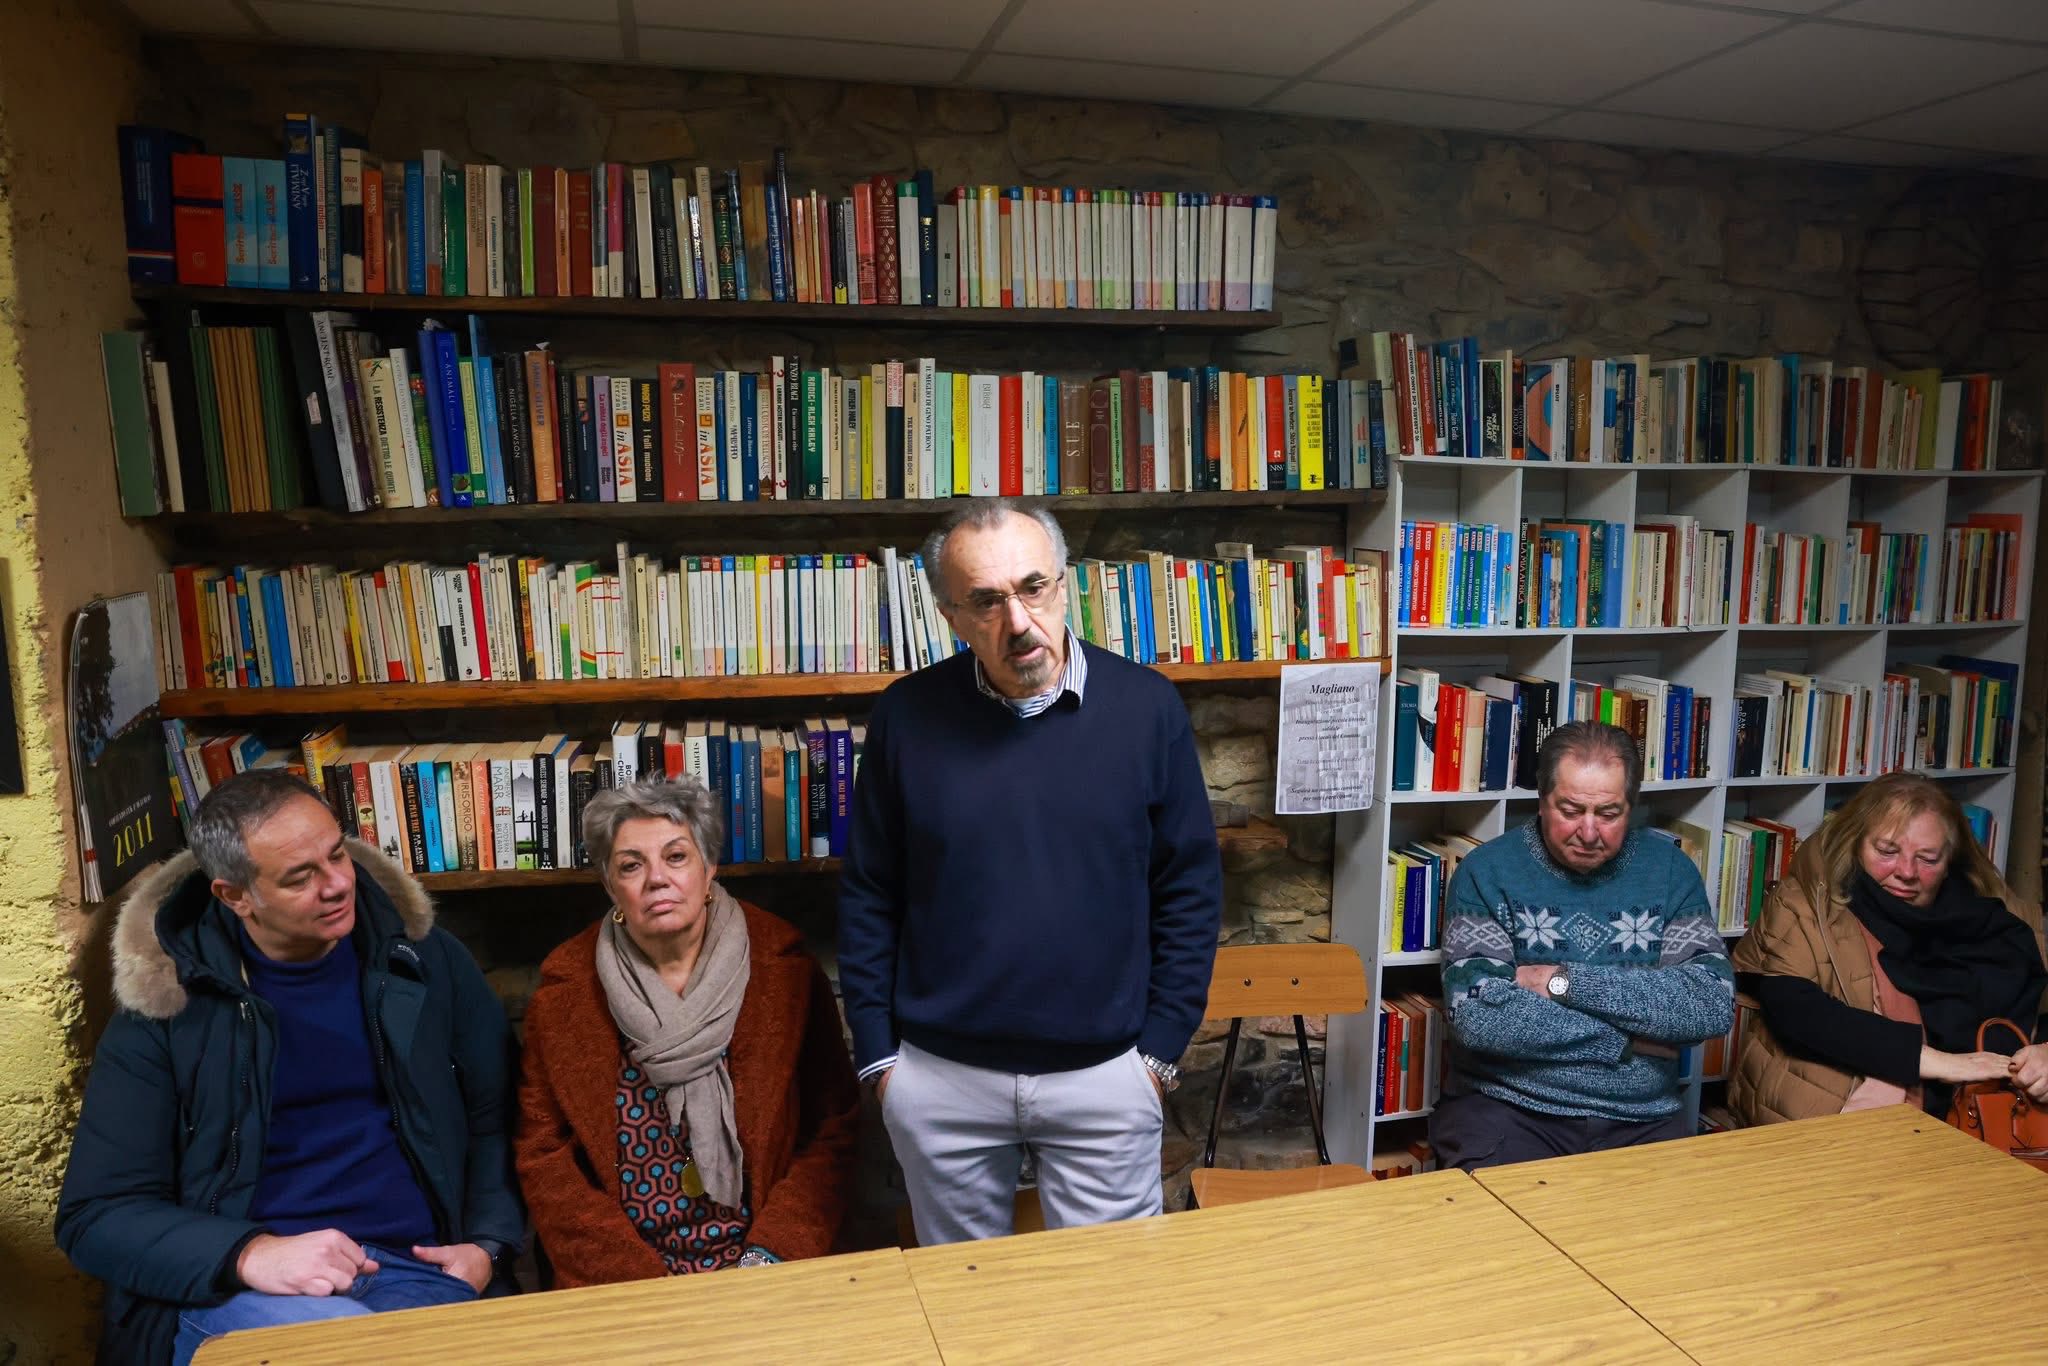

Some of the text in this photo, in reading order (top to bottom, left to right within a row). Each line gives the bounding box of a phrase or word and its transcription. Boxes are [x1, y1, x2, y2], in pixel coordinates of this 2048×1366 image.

[374, 396, 387, 436] RESISTENZA
[509, 388, 521, 459] NIGELLA LAWSON
[616, 443, 633, 487] ASIA
[700, 443, 716, 486] ASIA
[1309, 683, 1355, 695] Magliano
[493, 766, 504, 800] MARR
[538, 757, 548, 779] NAMELESS
[460, 782, 474, 832] IRIS ORIGO
[539, 779, 549, 799] SERENADE
[113, 811, 154, 867] 2011
